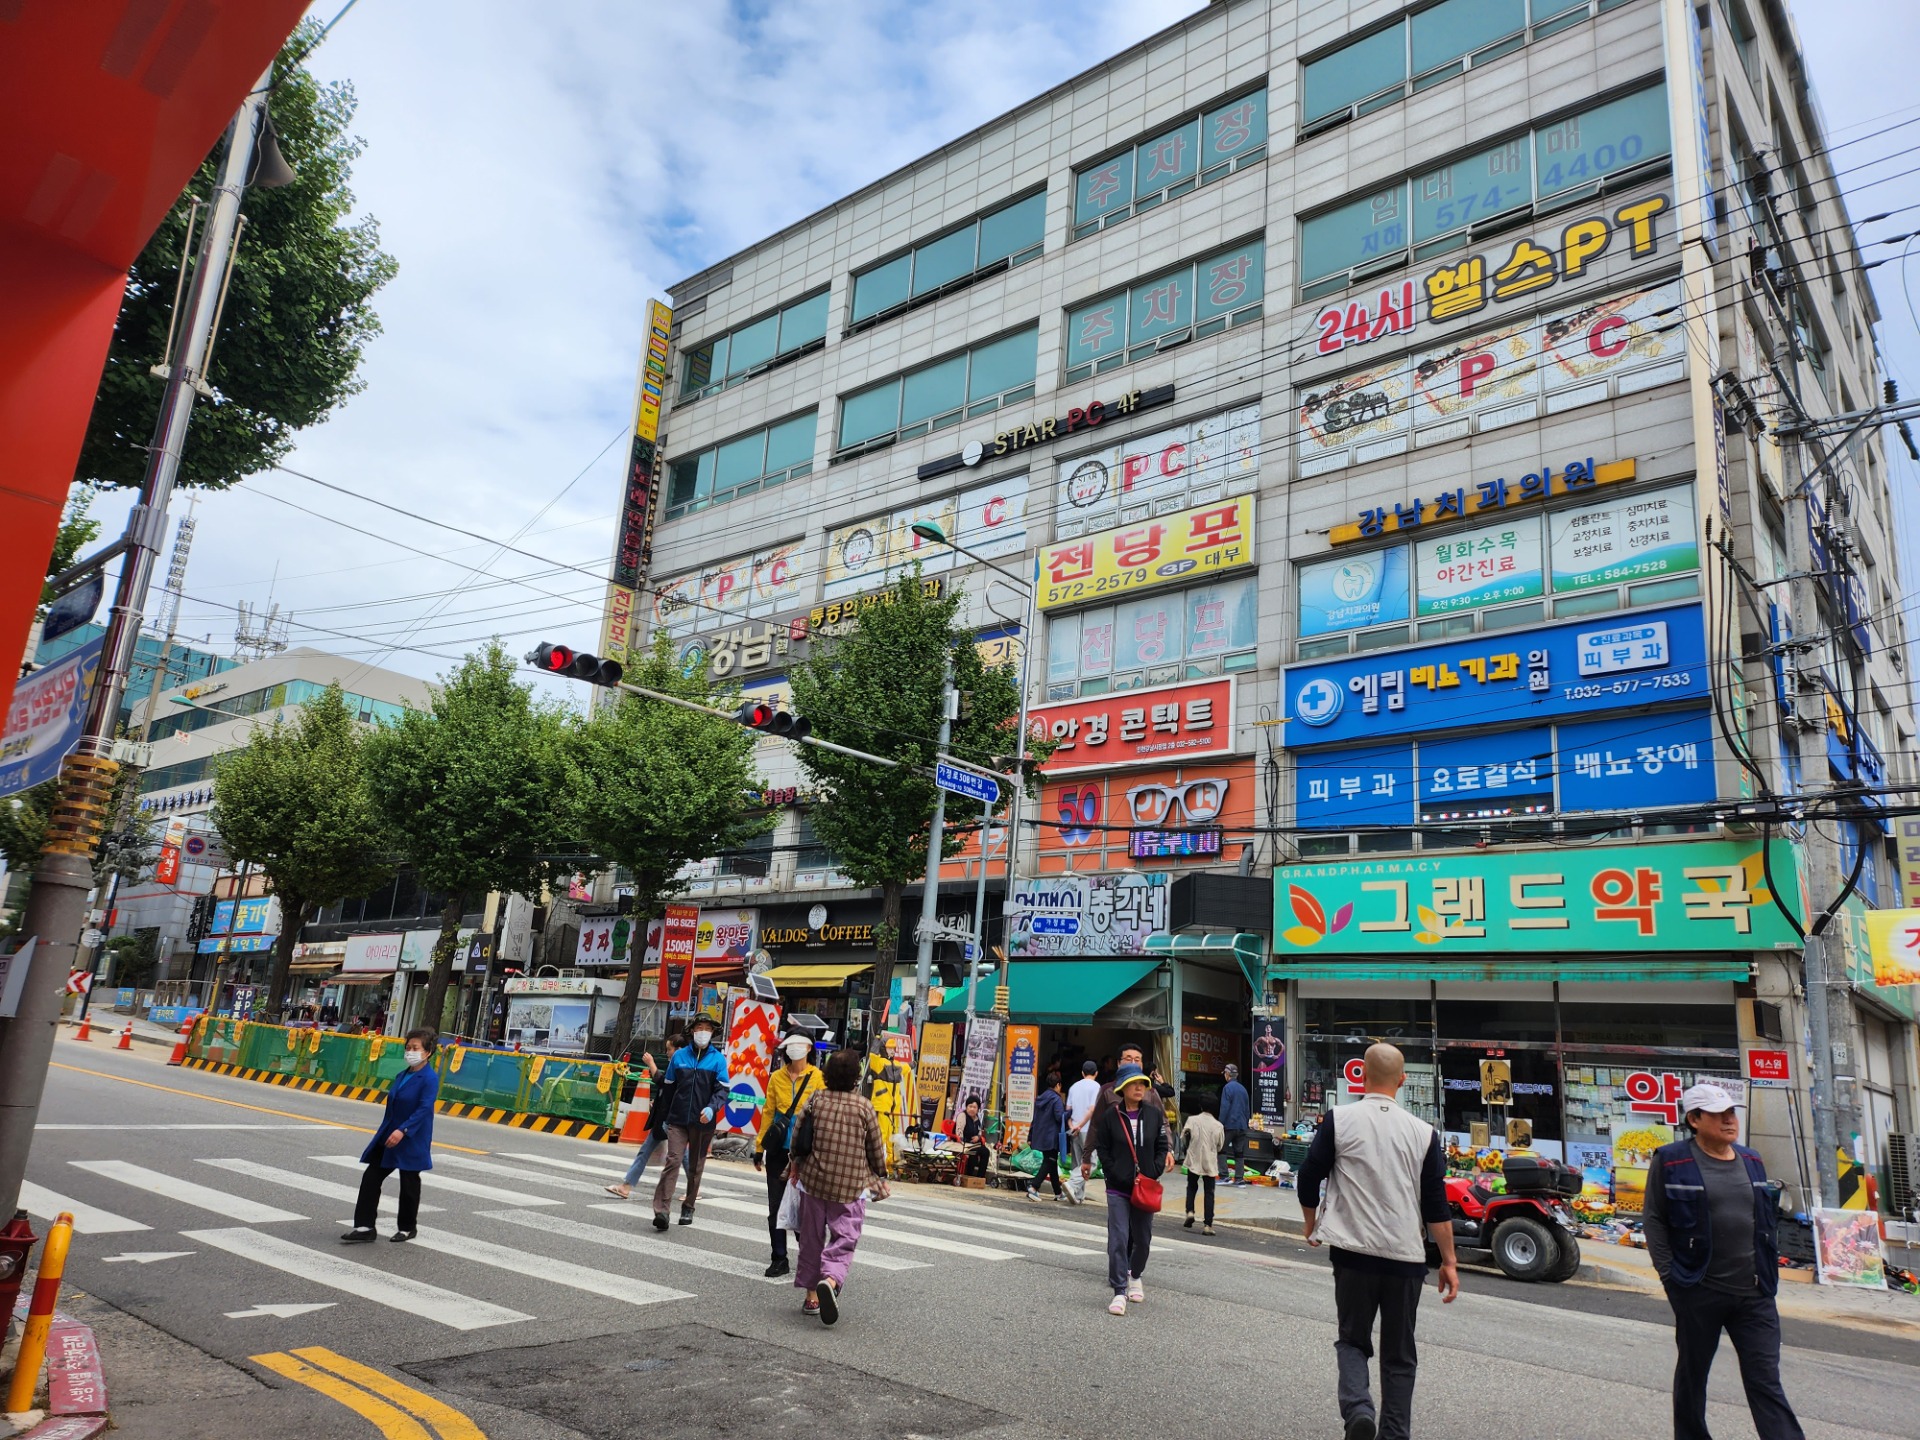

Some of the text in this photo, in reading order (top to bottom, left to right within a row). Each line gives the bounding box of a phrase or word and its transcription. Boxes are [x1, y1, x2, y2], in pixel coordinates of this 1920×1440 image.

[1371, 116, 1581, 226] 임대 매매
[1361, 223, 1402, 256] 지하
[1316, 278, 1416, 356] 24시
[994, 389, 1141, 455] STAR PC 4F
[1357, 457, 1598, 538] 강남치과의원
[1626, 499, 1668, 517] 심미치료
[1572, 526, 1613, 543] 교정치료
[1627, 514, 1670, 532] 충치치료
[1047, 504, 1242, 584] 전당포
[1435, 531, 1517, 563] 월화수목
[1572, 541, 1614, 558] 보철치료
[1628, 531, 1670, 549] 신경치료
[1048, 547, 1241, 602] 572-2579 3F 대부
[1436, 556, 1517, 585] 야간진료
[1572, 571, 1595, 586] TEL
[1604, 560, 1667, 580] 584-7528
[1326, 602, 1381, 620] 강남치과의원
[1431, 598, 1448, 610] 오전
[1450, 596, 1471, 607] 9:30
[1482, 591, 1500, 603] 오후
[1503, 585, 1525, 598] 9:00
[711, 623, 775, 676] 강남
[1083, 600, 1227, 670] 전당포
[1601, 628, 1643, 645] 진료과목
[1584, 643, 1662, 668] 피부과
[1348, 668, 1406, 715] 엘림
[1409, 652, 1522, 691] 비뇨기과
[1563, 673, 1691, 702] T.032-577-7533
[1051, 698, 1214, 750] 안경 콘택트
[1430, 757, 1538, 793] 요로결석
[1574, 742, 1699, 779] 배뇨장애
[1309, 773, 1396, 802] 피부과
[1057, 783, 1102, 832] 50
[164, 849, 178, 877] 우체국
[666, 917, 697, 927] BIG SIZE
[1090, 886, 1166, 933] 총각네
[665, 939, 693, 954] 1500원
[715, 924, 750, 948] 왕만두
[762, 923, 874, 943] VALDOS COFFEE
[1037, 936, 1060, 950] 과일
[1072, 935, 1096, 949] 야채
[1108, 935, 1134, 949] 생선
[365, 945, 398, 961] 아이리스
[921, 1066, 948, 1085] 1500원
[1755, 1058, 1782, 1069] 에스원
[1625, 1071, 1684, 1125] 약
